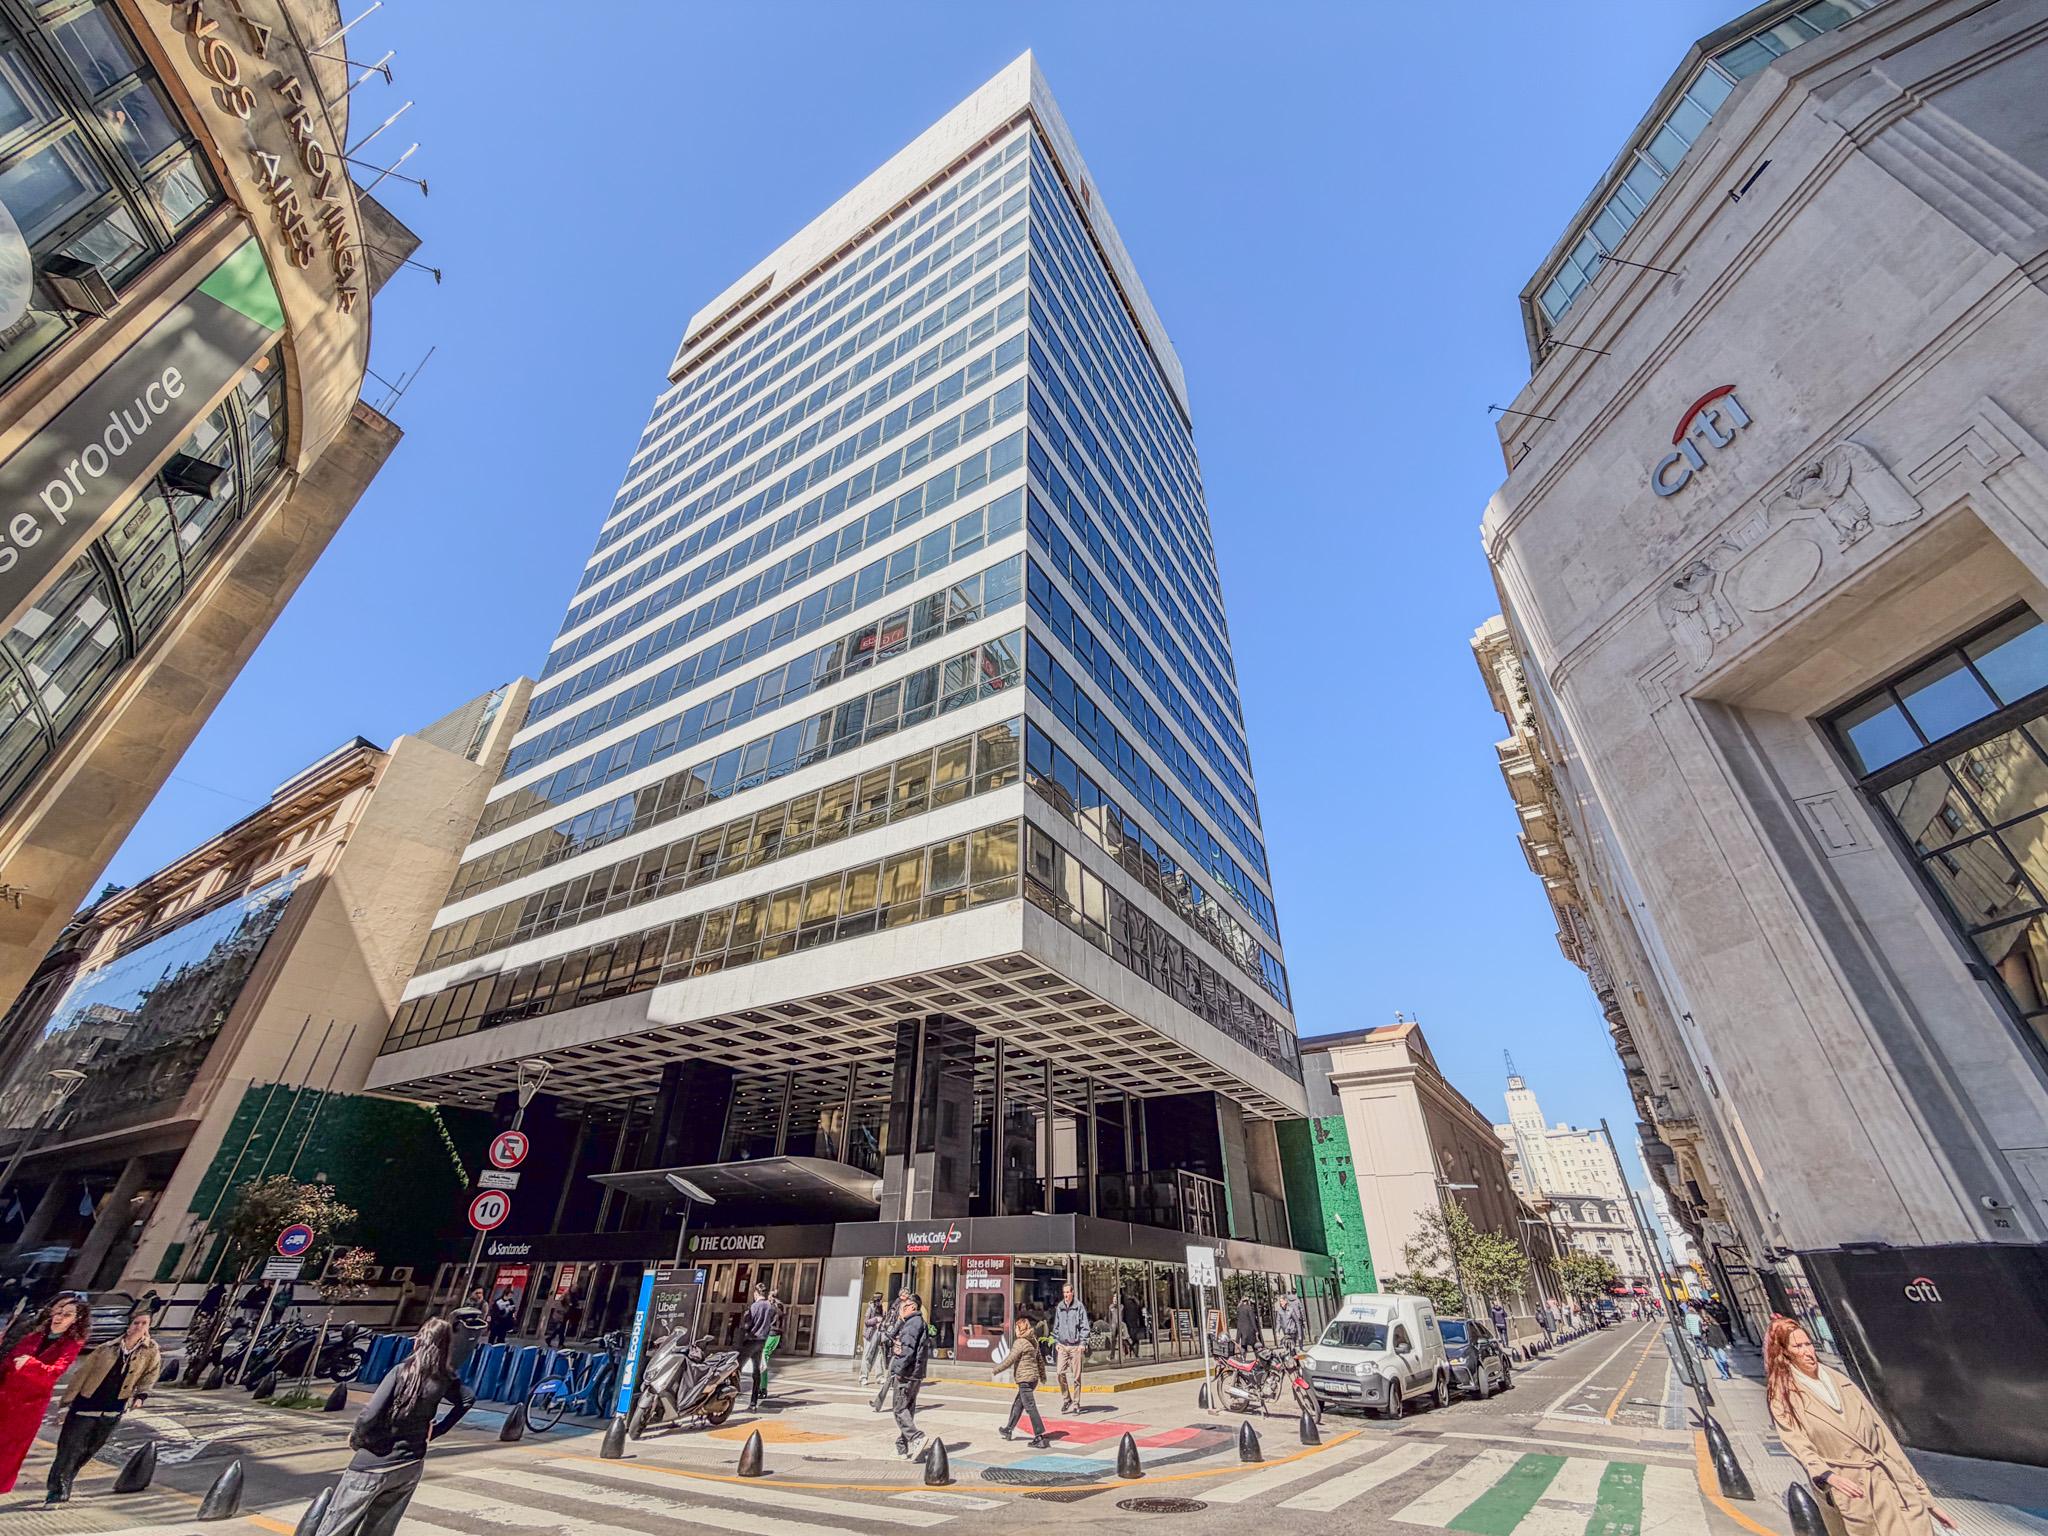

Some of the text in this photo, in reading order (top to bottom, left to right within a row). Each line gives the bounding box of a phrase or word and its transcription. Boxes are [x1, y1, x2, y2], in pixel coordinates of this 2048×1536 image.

[274, 74, 360, 315] PROVINCIA
[254, 149, 315, 271] AIRES
[38, 365, 186, 526] produce
[1652, 393, 1753, 497] citi
[480, 1201, 501, 1218] 10
[700, 1234, 766, 1251] THE CORNER
[907, 1230, 947, 1244] Work Café
[496, 1243, 532, 1255] Santander
[1904, 1280, 1943, 1302] citi
[657, 1302, 678, 1312] Uber
